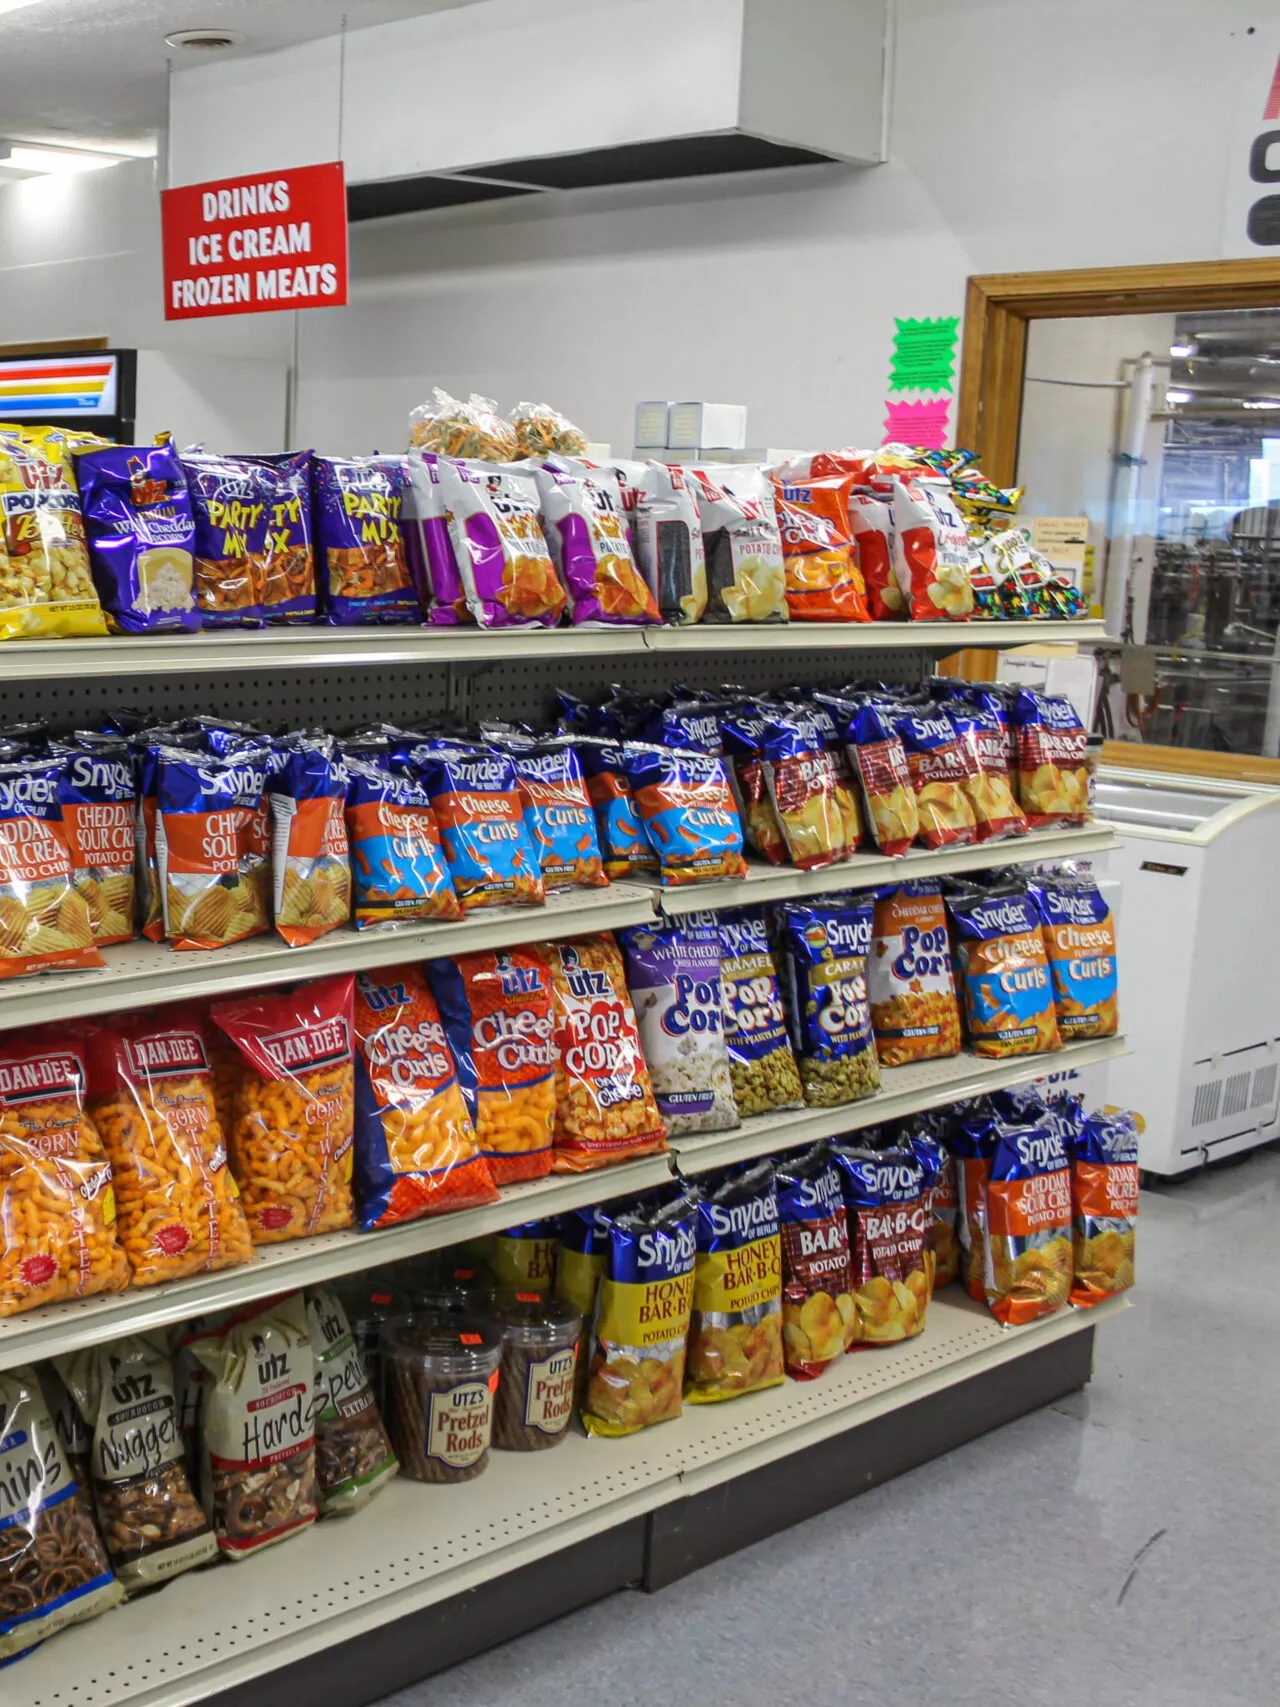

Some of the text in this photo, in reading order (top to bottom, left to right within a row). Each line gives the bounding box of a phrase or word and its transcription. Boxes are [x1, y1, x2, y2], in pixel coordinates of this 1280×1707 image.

[202, 180, 290, 222] DRINKS
[188, 222, 311, 266] ICE CREAM
[172, 263, 337, 309] FROZEN MEATS
[207, 500, 263, 530] PARTY
[344, 493, 402, 518] PARTY
[361, 519, 401, 546] MIX
[462, 795, 513, 815] Cheese
[544, 807, 587, 827] Curls
[77, 828, 108, 850] SOUR
[476, 822, 519, 843] Curls
[84, 850, 120, 865] POTATO
[971, 903, 1025, 932] Snyder
[986, 938, 1044, 964] Cheese
[1057, 928, 1112, 951] Cheese
[1000, 969, 1047, 993] Curls
[1069, 958, 1112, 981] Curls
[575, 1011, 620, 1042] POP
[365, 1021, 446, 1065] Cheese
[566, 1034, 640, 1075] CORN
[391, 1051, 449, 1086] Curls
[669, 1092, 697, 1103] GLUTEN
[166, 1105, 209, 1131] CORN
[305, 1099, 343, 1125] CORN
[28, 1131, 79, 1158] CORN
[711, 1195, 778, 1238] Snyder
[727, 1240, 777, 1272] HONEY
[643, 1327, 675, 1343] POTATO
[453, 1389, 484, 1407] UTZ'S
[438, 1404, 489, 1432] Pretzel
[446, 1430, 482, 1452] Rods
